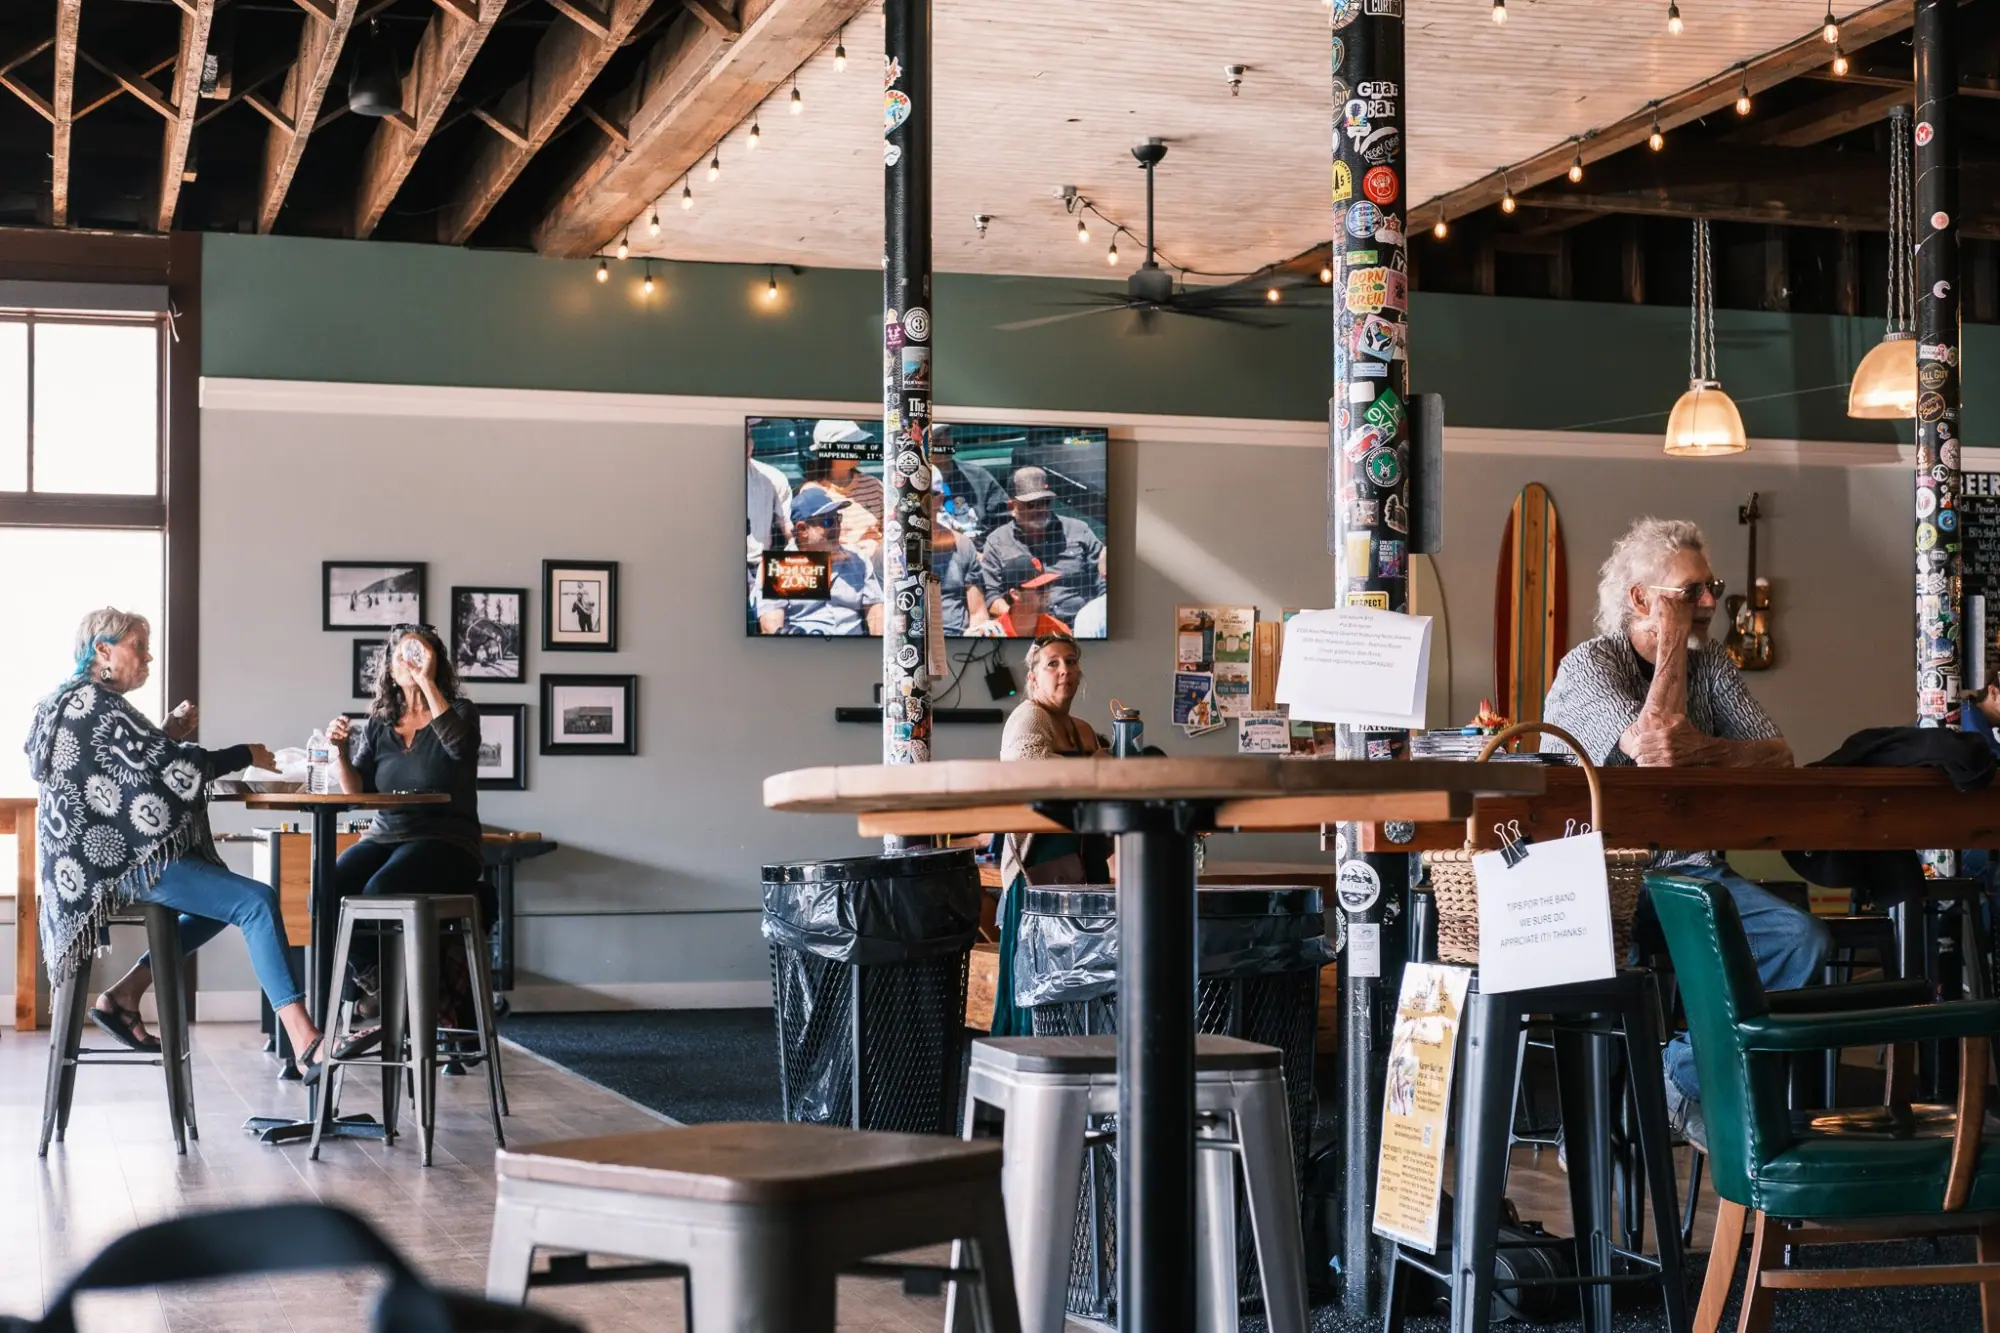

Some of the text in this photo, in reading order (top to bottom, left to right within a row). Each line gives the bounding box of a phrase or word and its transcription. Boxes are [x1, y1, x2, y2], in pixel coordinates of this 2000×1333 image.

[908, 398, 925, 413] The
[819, 452, 862, 460] HAPPENING.
[1961, 473, 2000, 496] EER
[781, 576, 818, 589] ZONE
[1506, 892, 1576, 912] TIPS FOR THE BAND
[1519, 911, 1565, 927] WE SURE DO
